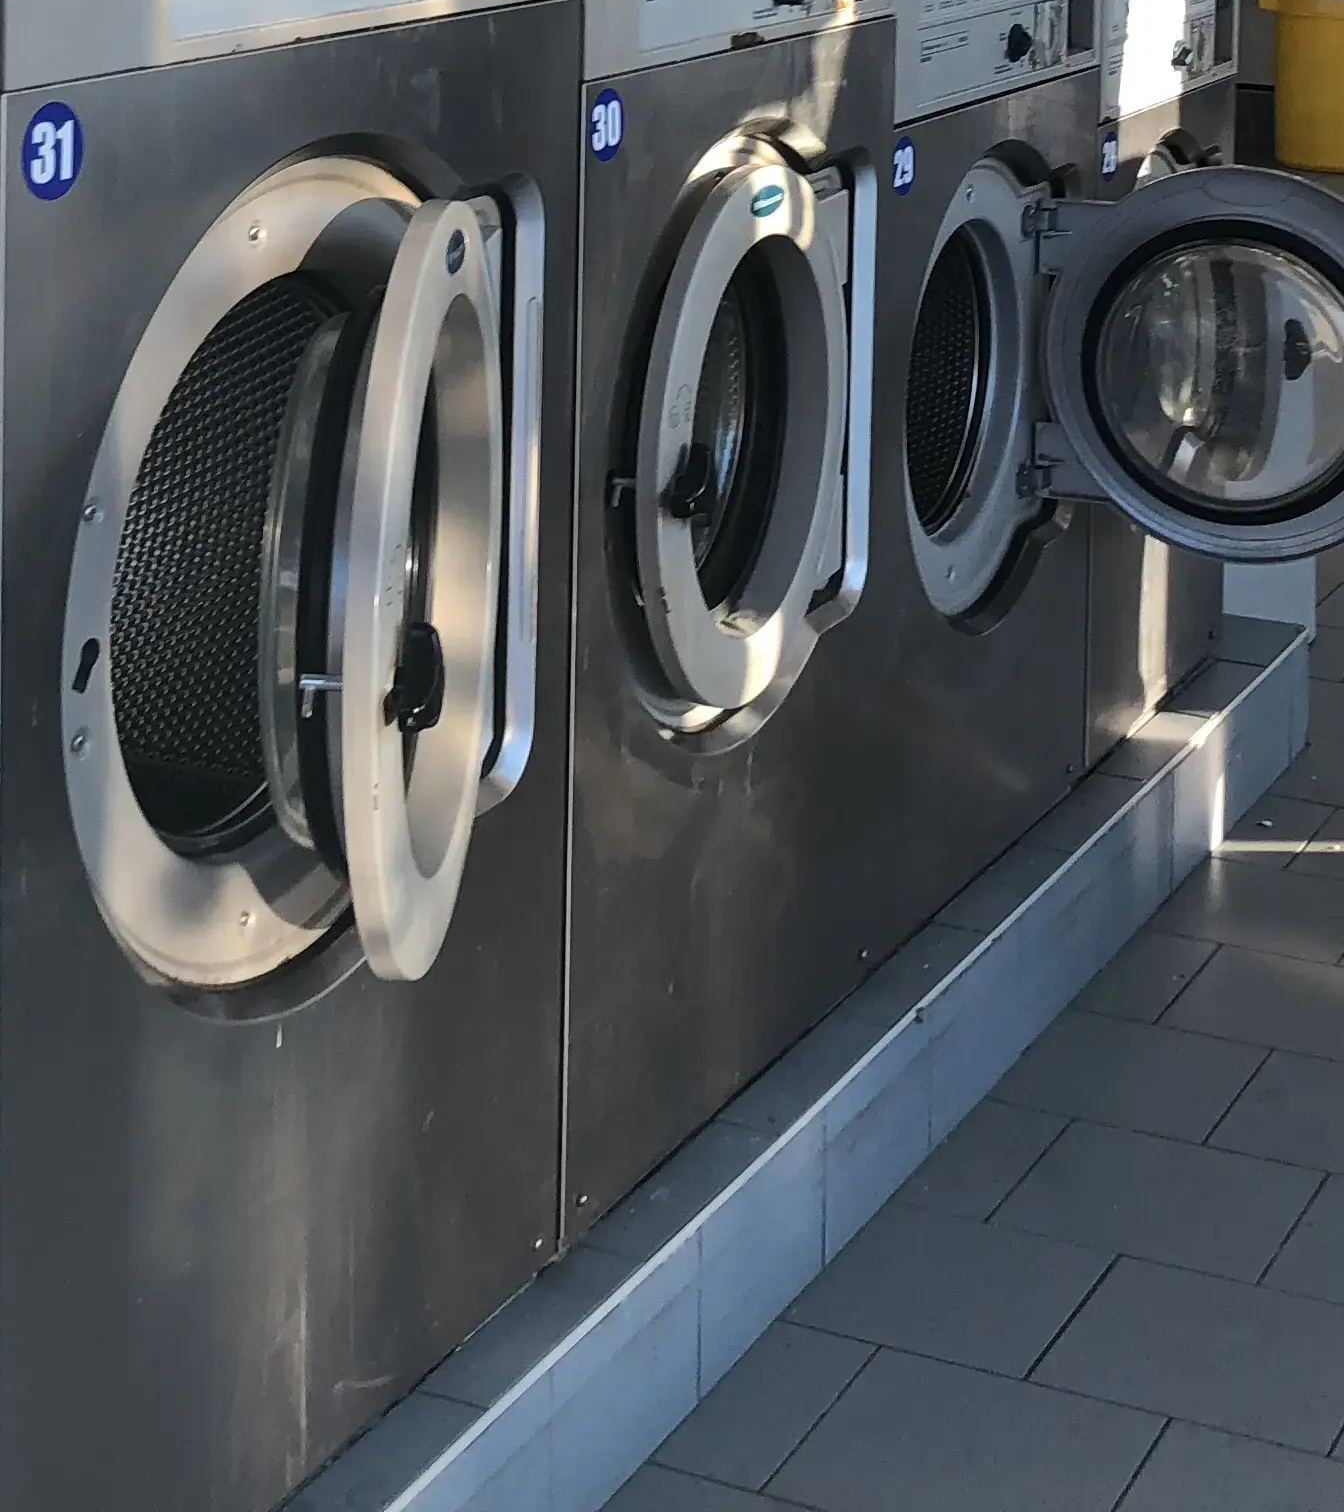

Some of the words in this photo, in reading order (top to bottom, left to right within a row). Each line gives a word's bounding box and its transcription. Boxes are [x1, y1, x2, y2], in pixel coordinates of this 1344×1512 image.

[591, 100, 622, 152] 30
[29, 120, 74, 185] 31
[893, 145, 913, 188] 29
